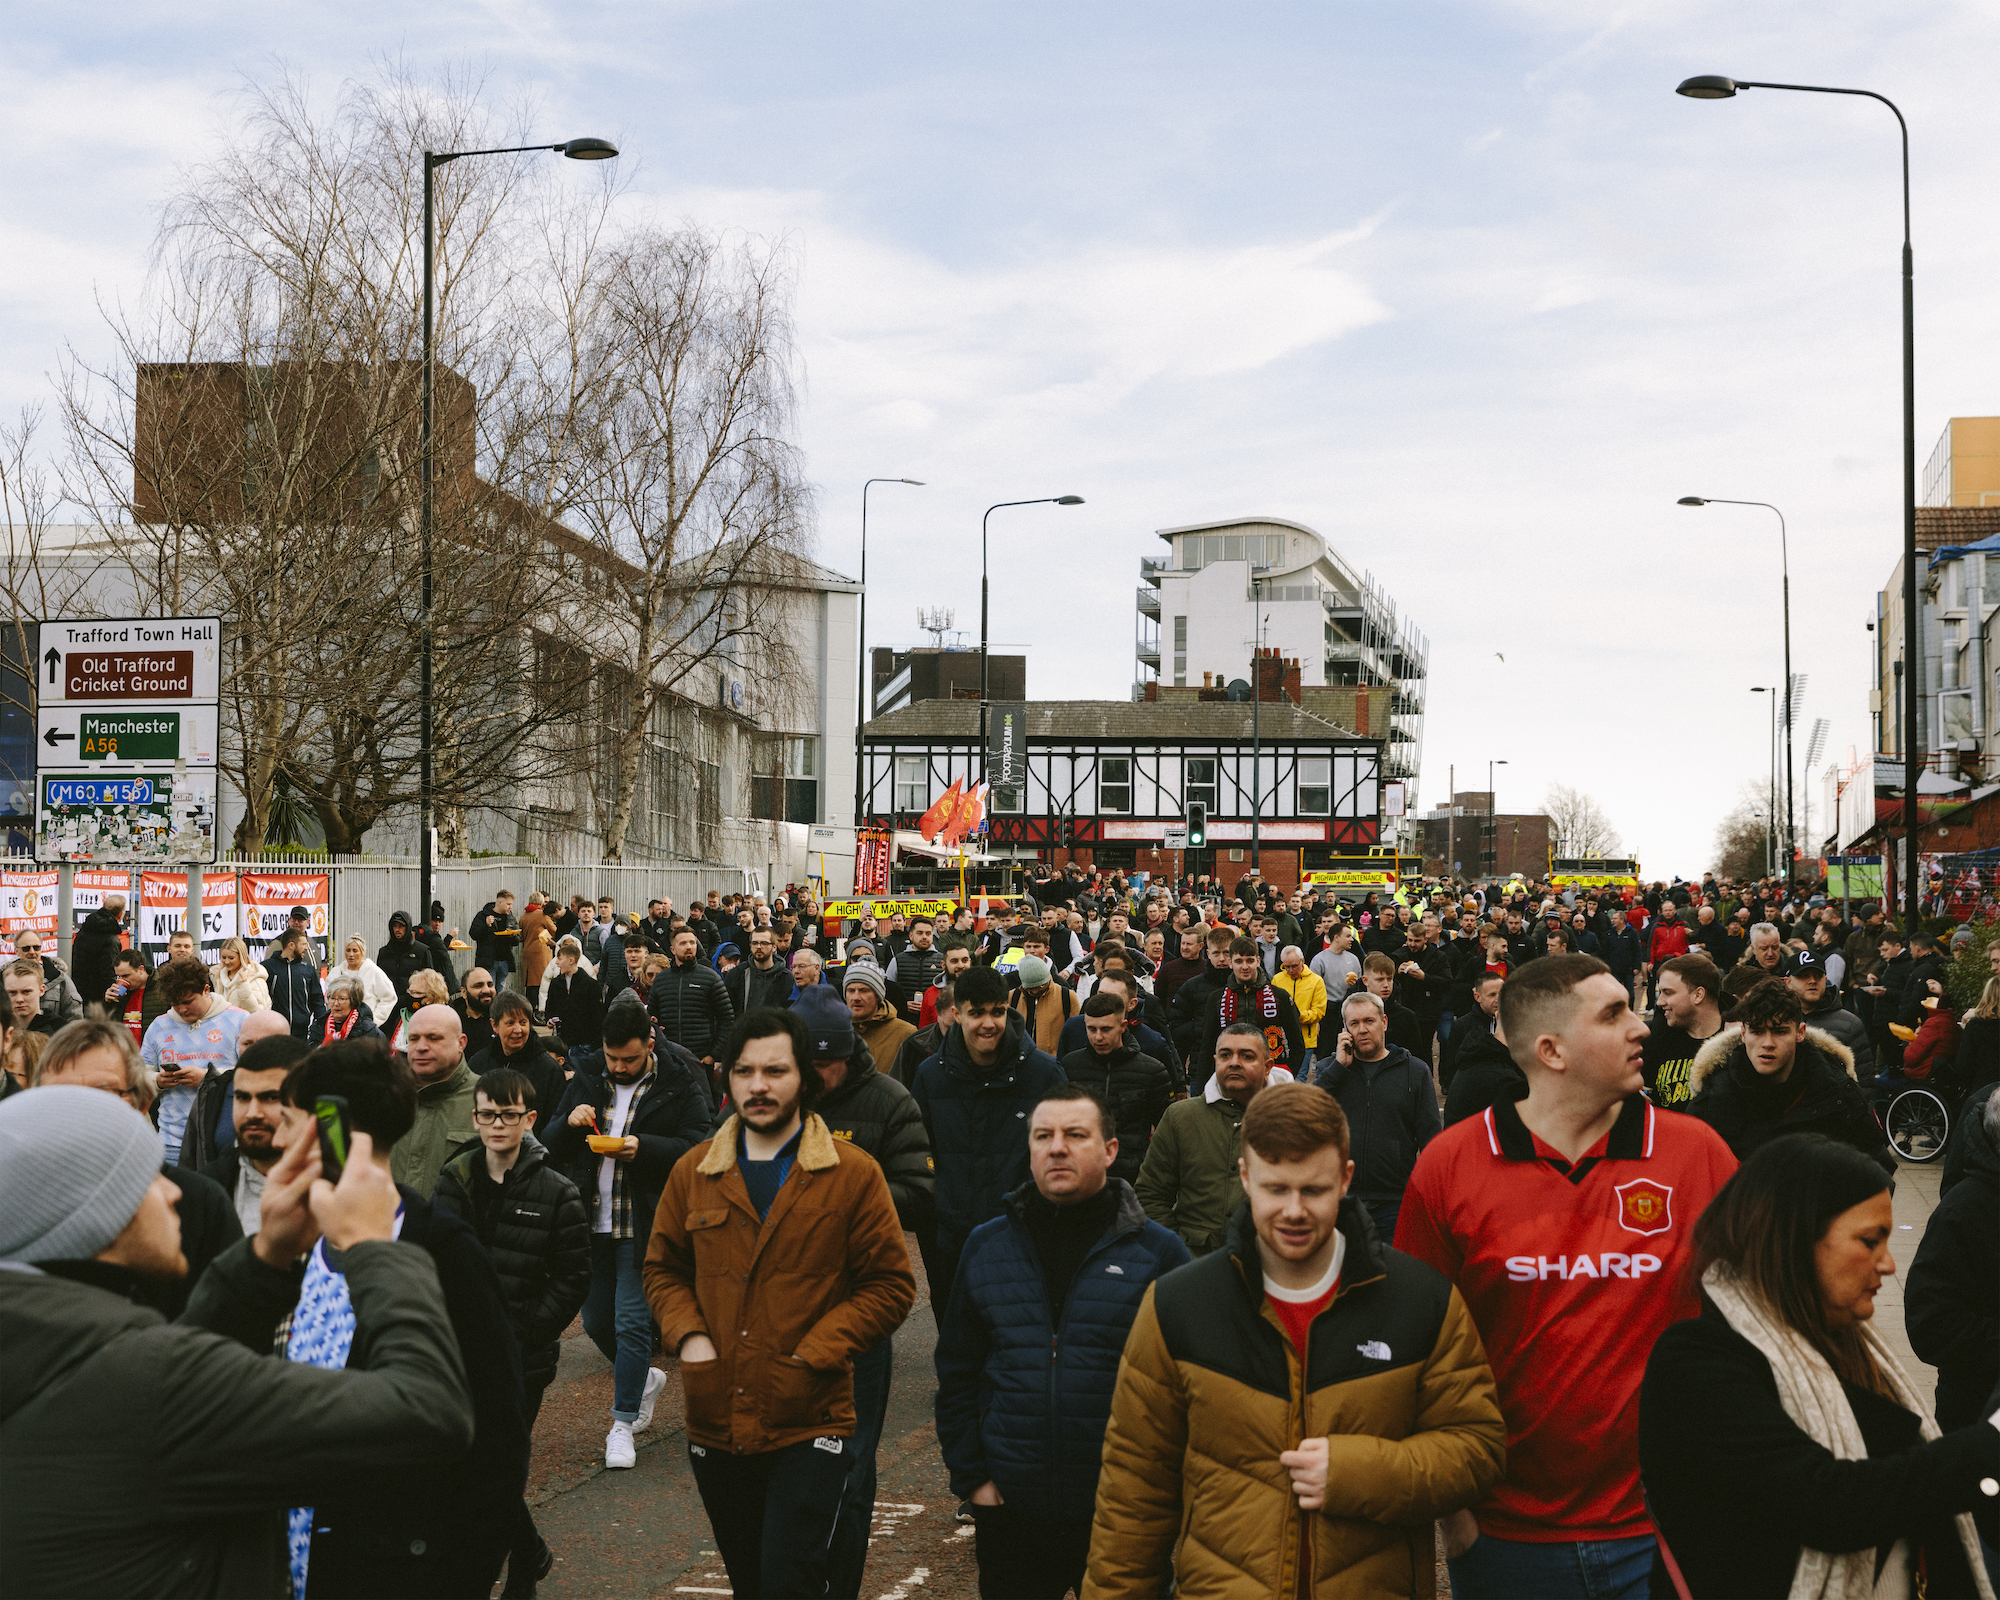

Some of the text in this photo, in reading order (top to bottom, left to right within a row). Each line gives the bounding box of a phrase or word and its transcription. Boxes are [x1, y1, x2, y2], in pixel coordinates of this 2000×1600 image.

[66, 626, 213, 643] Trafford Town Hall
[82, 657, 176, 673] Old Trafford
[70, 675, 188, 693] Cricket Ground
[86, 719, 175, 734] Manchester
[1002, 726, 1013, 780] FOOTASYLUM
[1205, 823, 1267, 838] AFFORD
[74, 873, 129, 887] PRIDE OF ALL EUROPE
[1314, 874, 1341, 882] HIGHWAY
[144, 880, 165, 898] SENT
[165, 882, 176, 898] TO
[254, 880, 319, 900] ON THE 8th DAY
[836, 902, 948, 915] HIGHY MAINTENANCE
[37, 917, 53, 931] CLUB
[202, 911, 223, 934] FC
[262, 913, 278, 931] GOD
[174, 1051, 224, 1061] TeamViewer
[1655, 1058, 1694, 1092] BILLIO
[1505, 1252, 1662, 1282] SHARP
